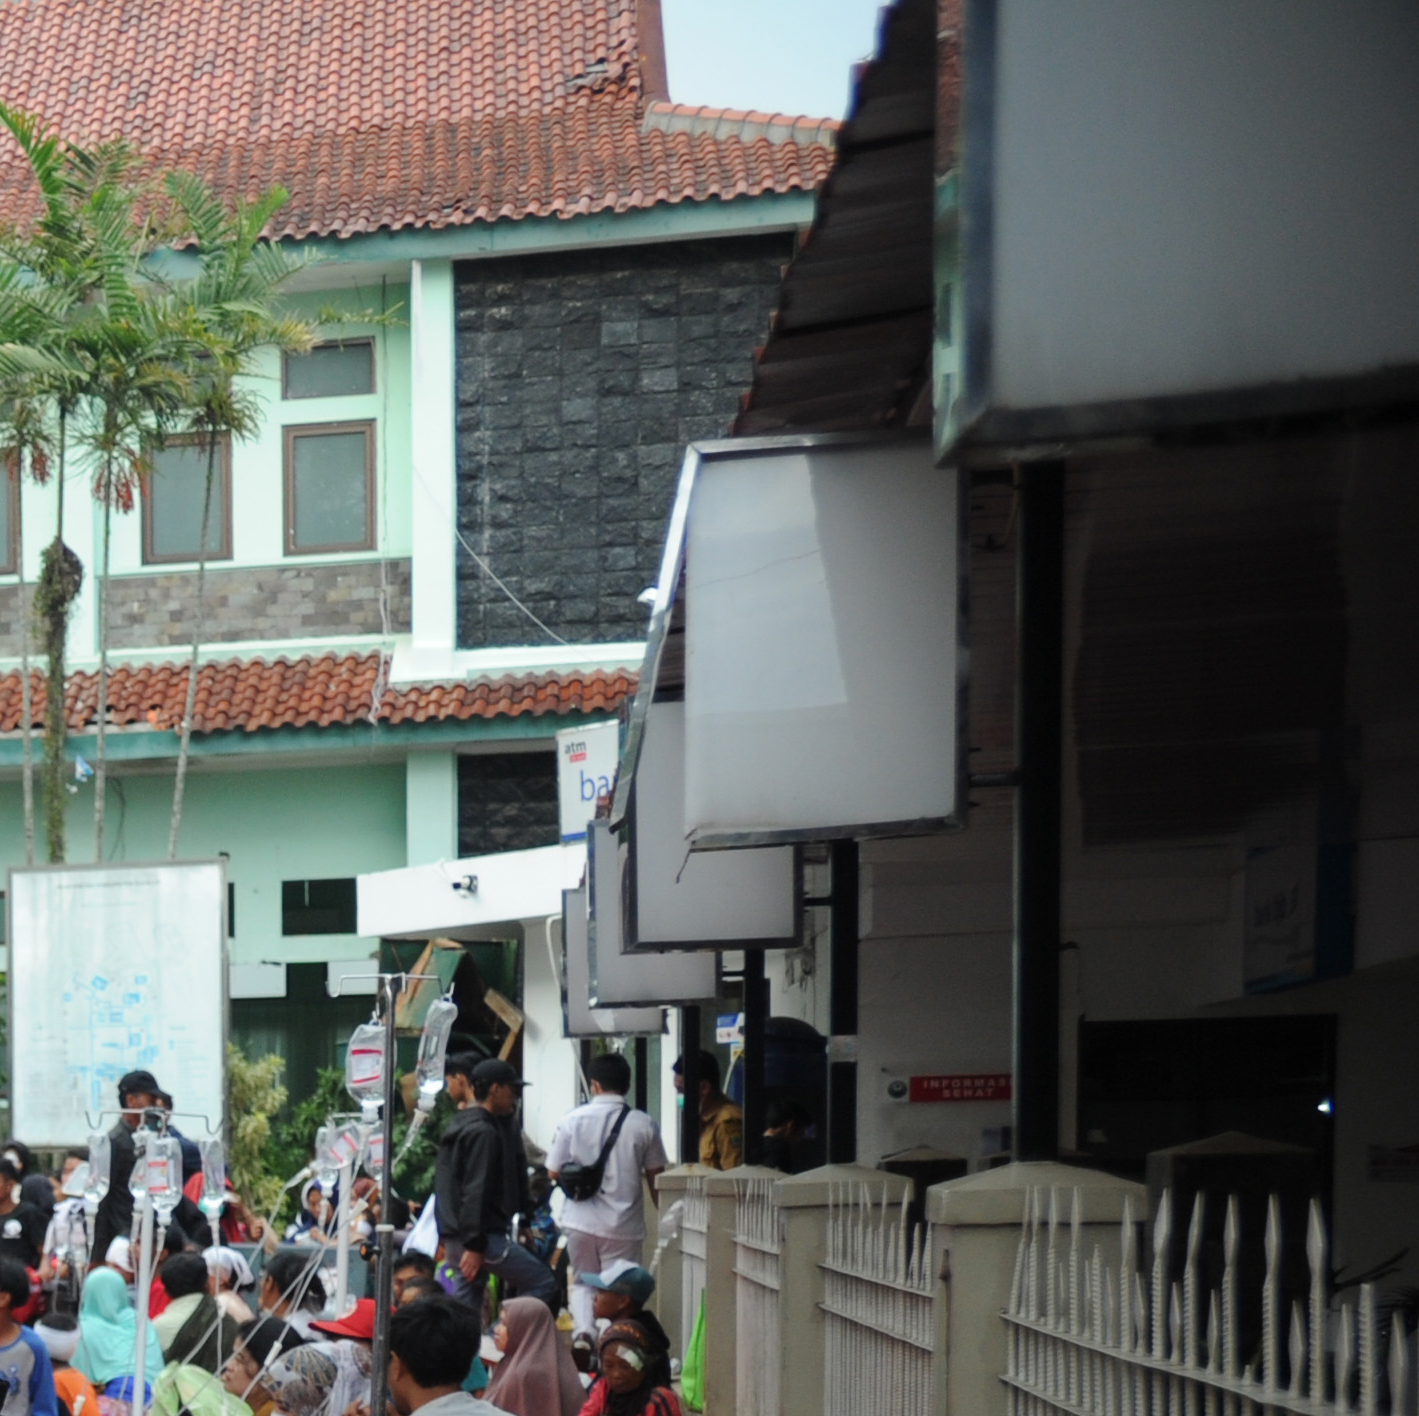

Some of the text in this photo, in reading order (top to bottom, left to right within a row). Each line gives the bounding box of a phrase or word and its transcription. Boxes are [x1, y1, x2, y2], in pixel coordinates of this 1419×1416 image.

[565, 741, 587, 754] atm
[580, 769, 618, 802] ba
[923, 1078, 1011, 1089] INFORMAS
[942, 1088, 993, 1098] SEHAT
